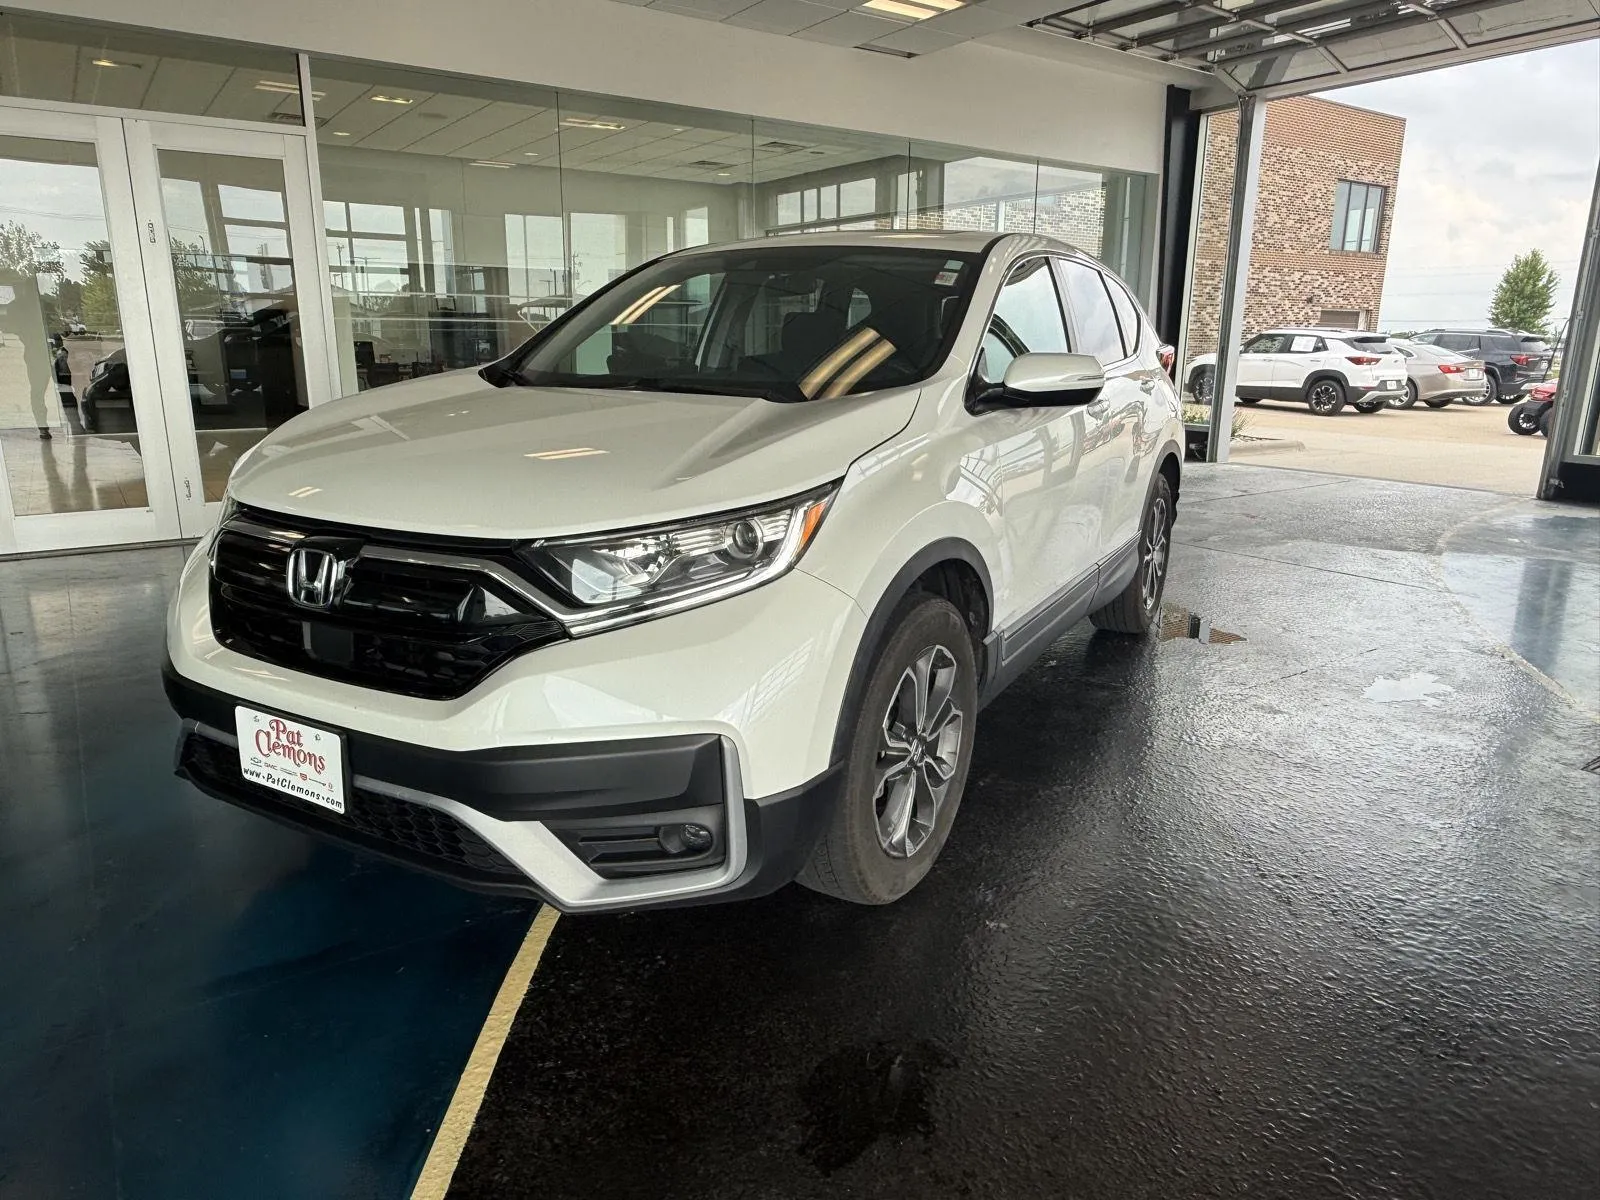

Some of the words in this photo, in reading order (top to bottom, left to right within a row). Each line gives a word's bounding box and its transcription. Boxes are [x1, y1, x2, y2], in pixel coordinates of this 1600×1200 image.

[255, 729, 326, 775] Clemons
[269, 719, 303, 747] Pat
[243, 767, 342, 809] www.PatClemons.com
